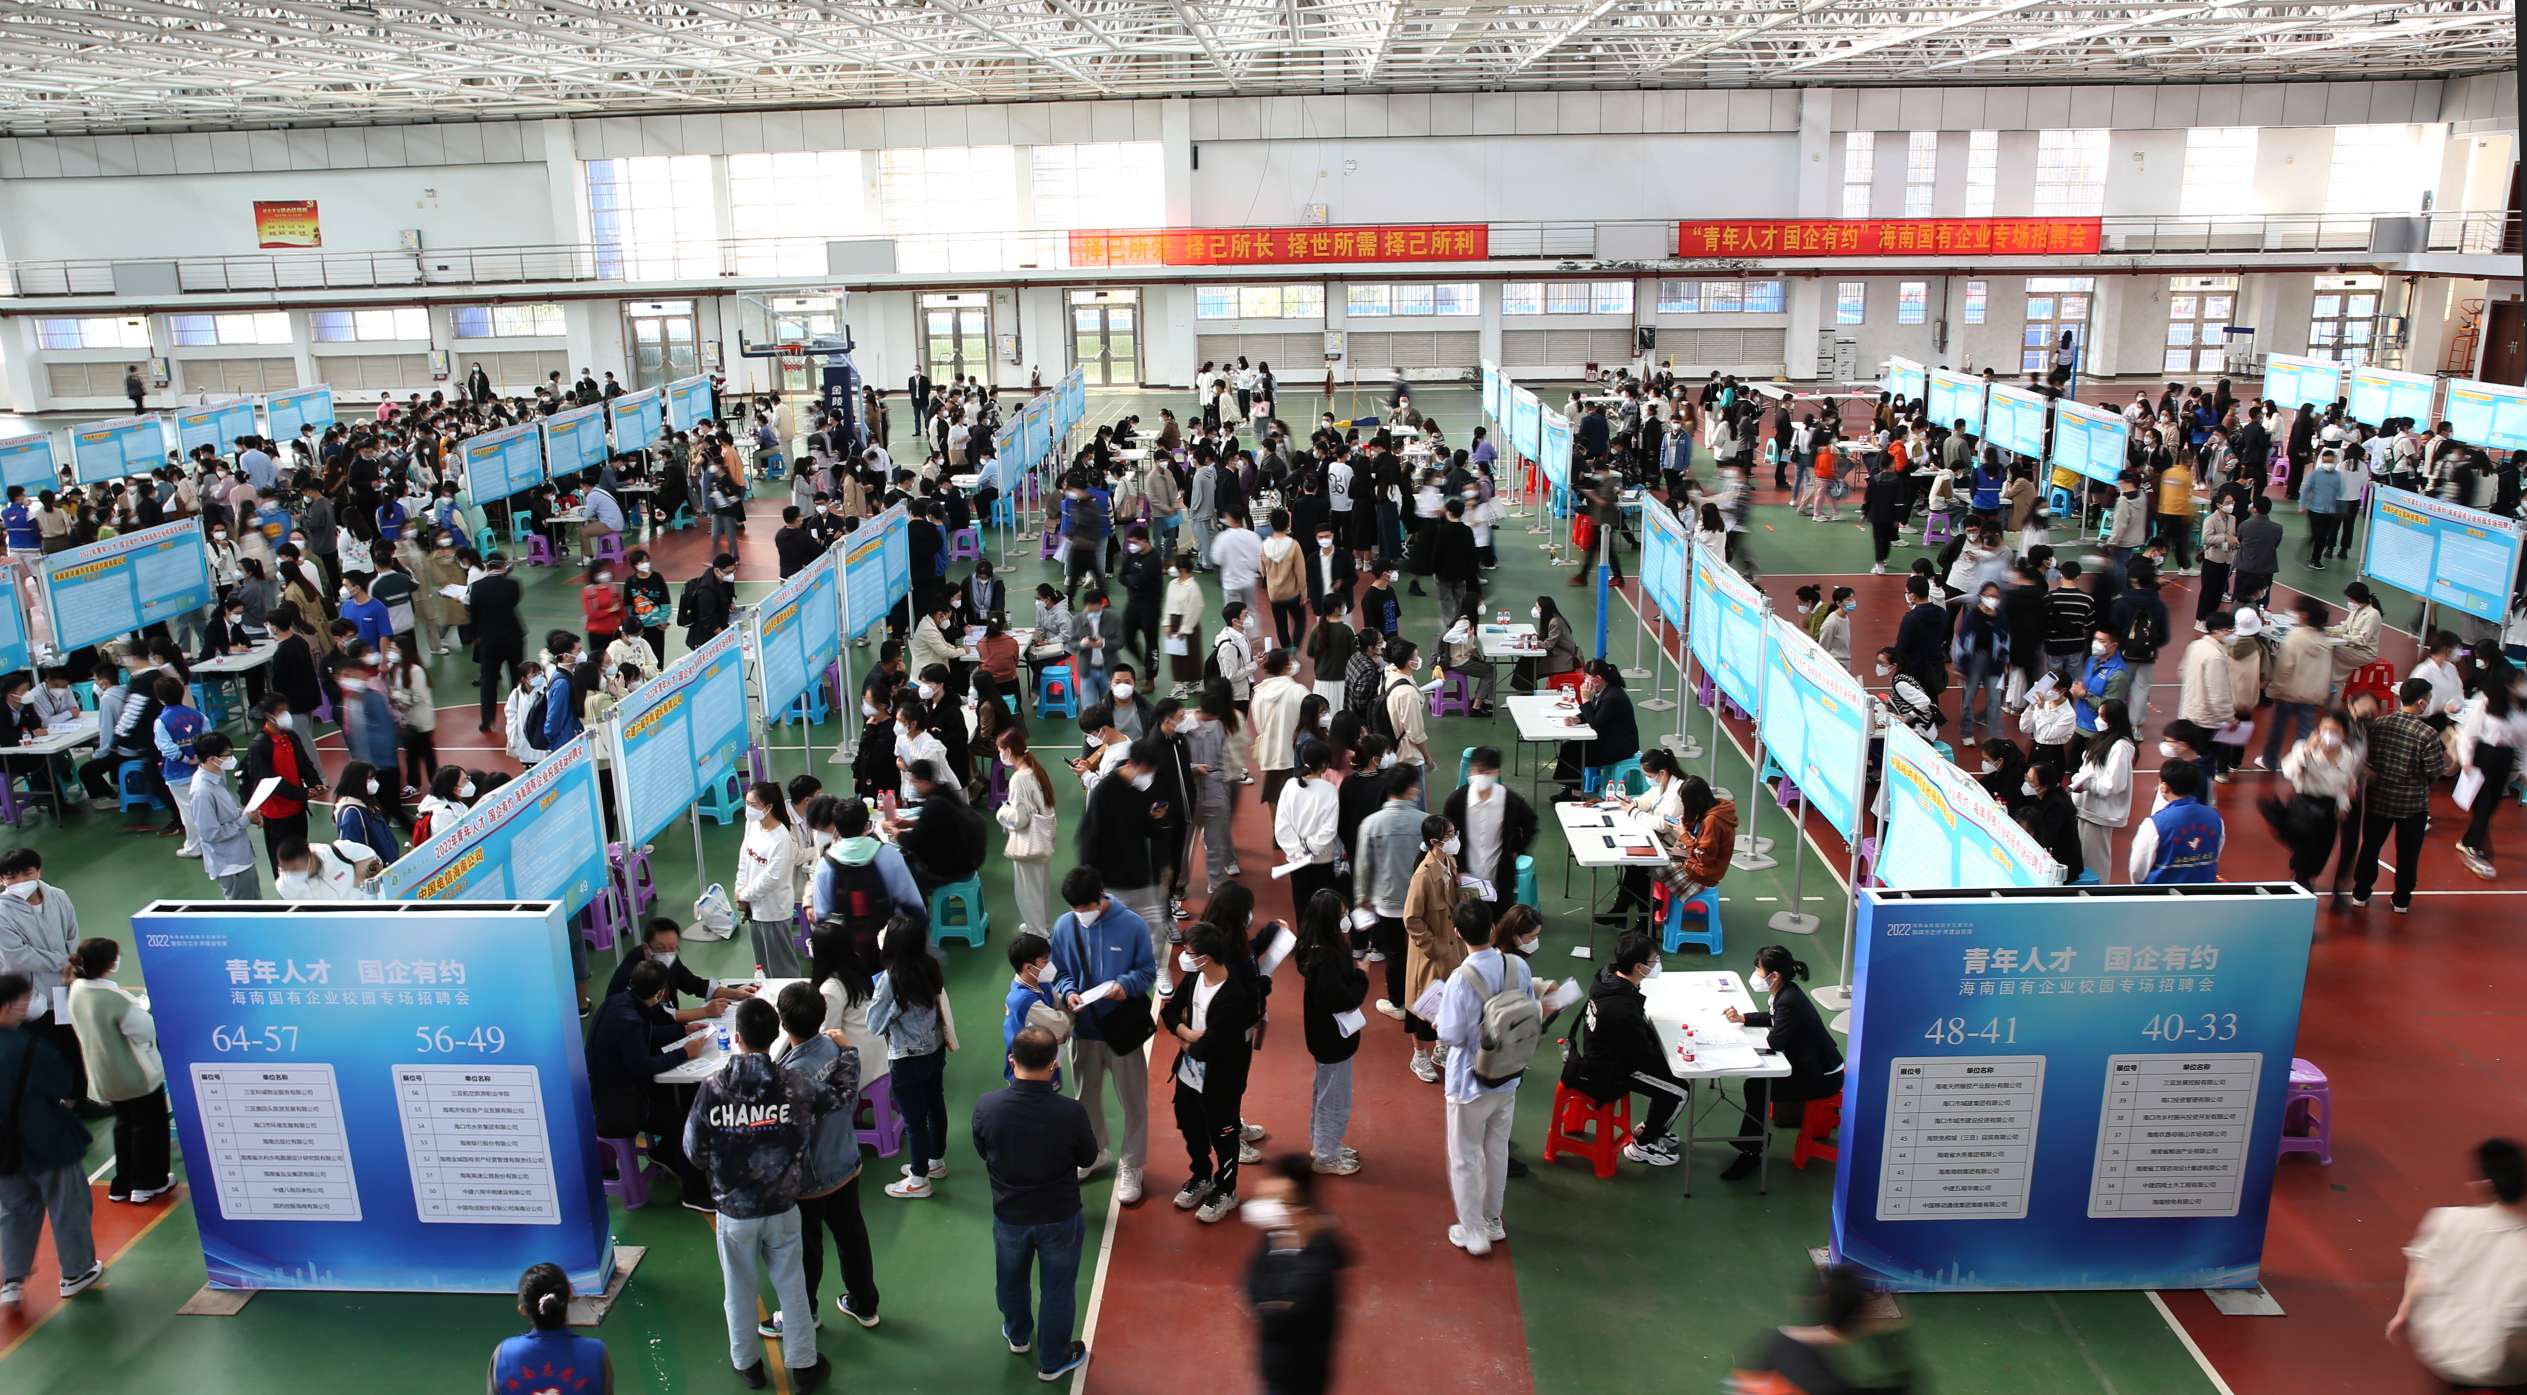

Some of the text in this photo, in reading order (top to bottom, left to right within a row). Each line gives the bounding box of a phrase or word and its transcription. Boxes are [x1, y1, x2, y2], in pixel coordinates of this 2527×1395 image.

[1185, 233, 1275, 260] 择己所长
[1287, 231, 1378, 258] 择世所需
[1384, 229, 1475, 256] 择己所利
[1879, 223, 2087, 250] 海南国有企业专场招聘会
[418, 847, 484, 899] 中国电信海南公司
[1887, 922, 1911, 936] 2022
[146, 934, 170, 947] 2022
[1963, 944, 2219, 974] 青年人才 国企有约
[225, 959, 466, 985] 青年人才 国企有约
[1959, 979, 2216, 996] 海南国有企业校园专场招聘会
[231, 990, 471, 1006] 海南国有企业校园专场招聘会
[211, 1024, 506, 1054] 64-57 56-49
[1924, 1013, 2238, 1045] 48-41 40-33
[1966, 1066, 1994, 1074] 单位名称
[2183, 1063, 2210, 1071] 单位名称
[263, 1073, 288, 1082] 单位名称
[465, 1075, 491, 1083] 单位名称
[709, 1103, 791, 1127] CHANGE
